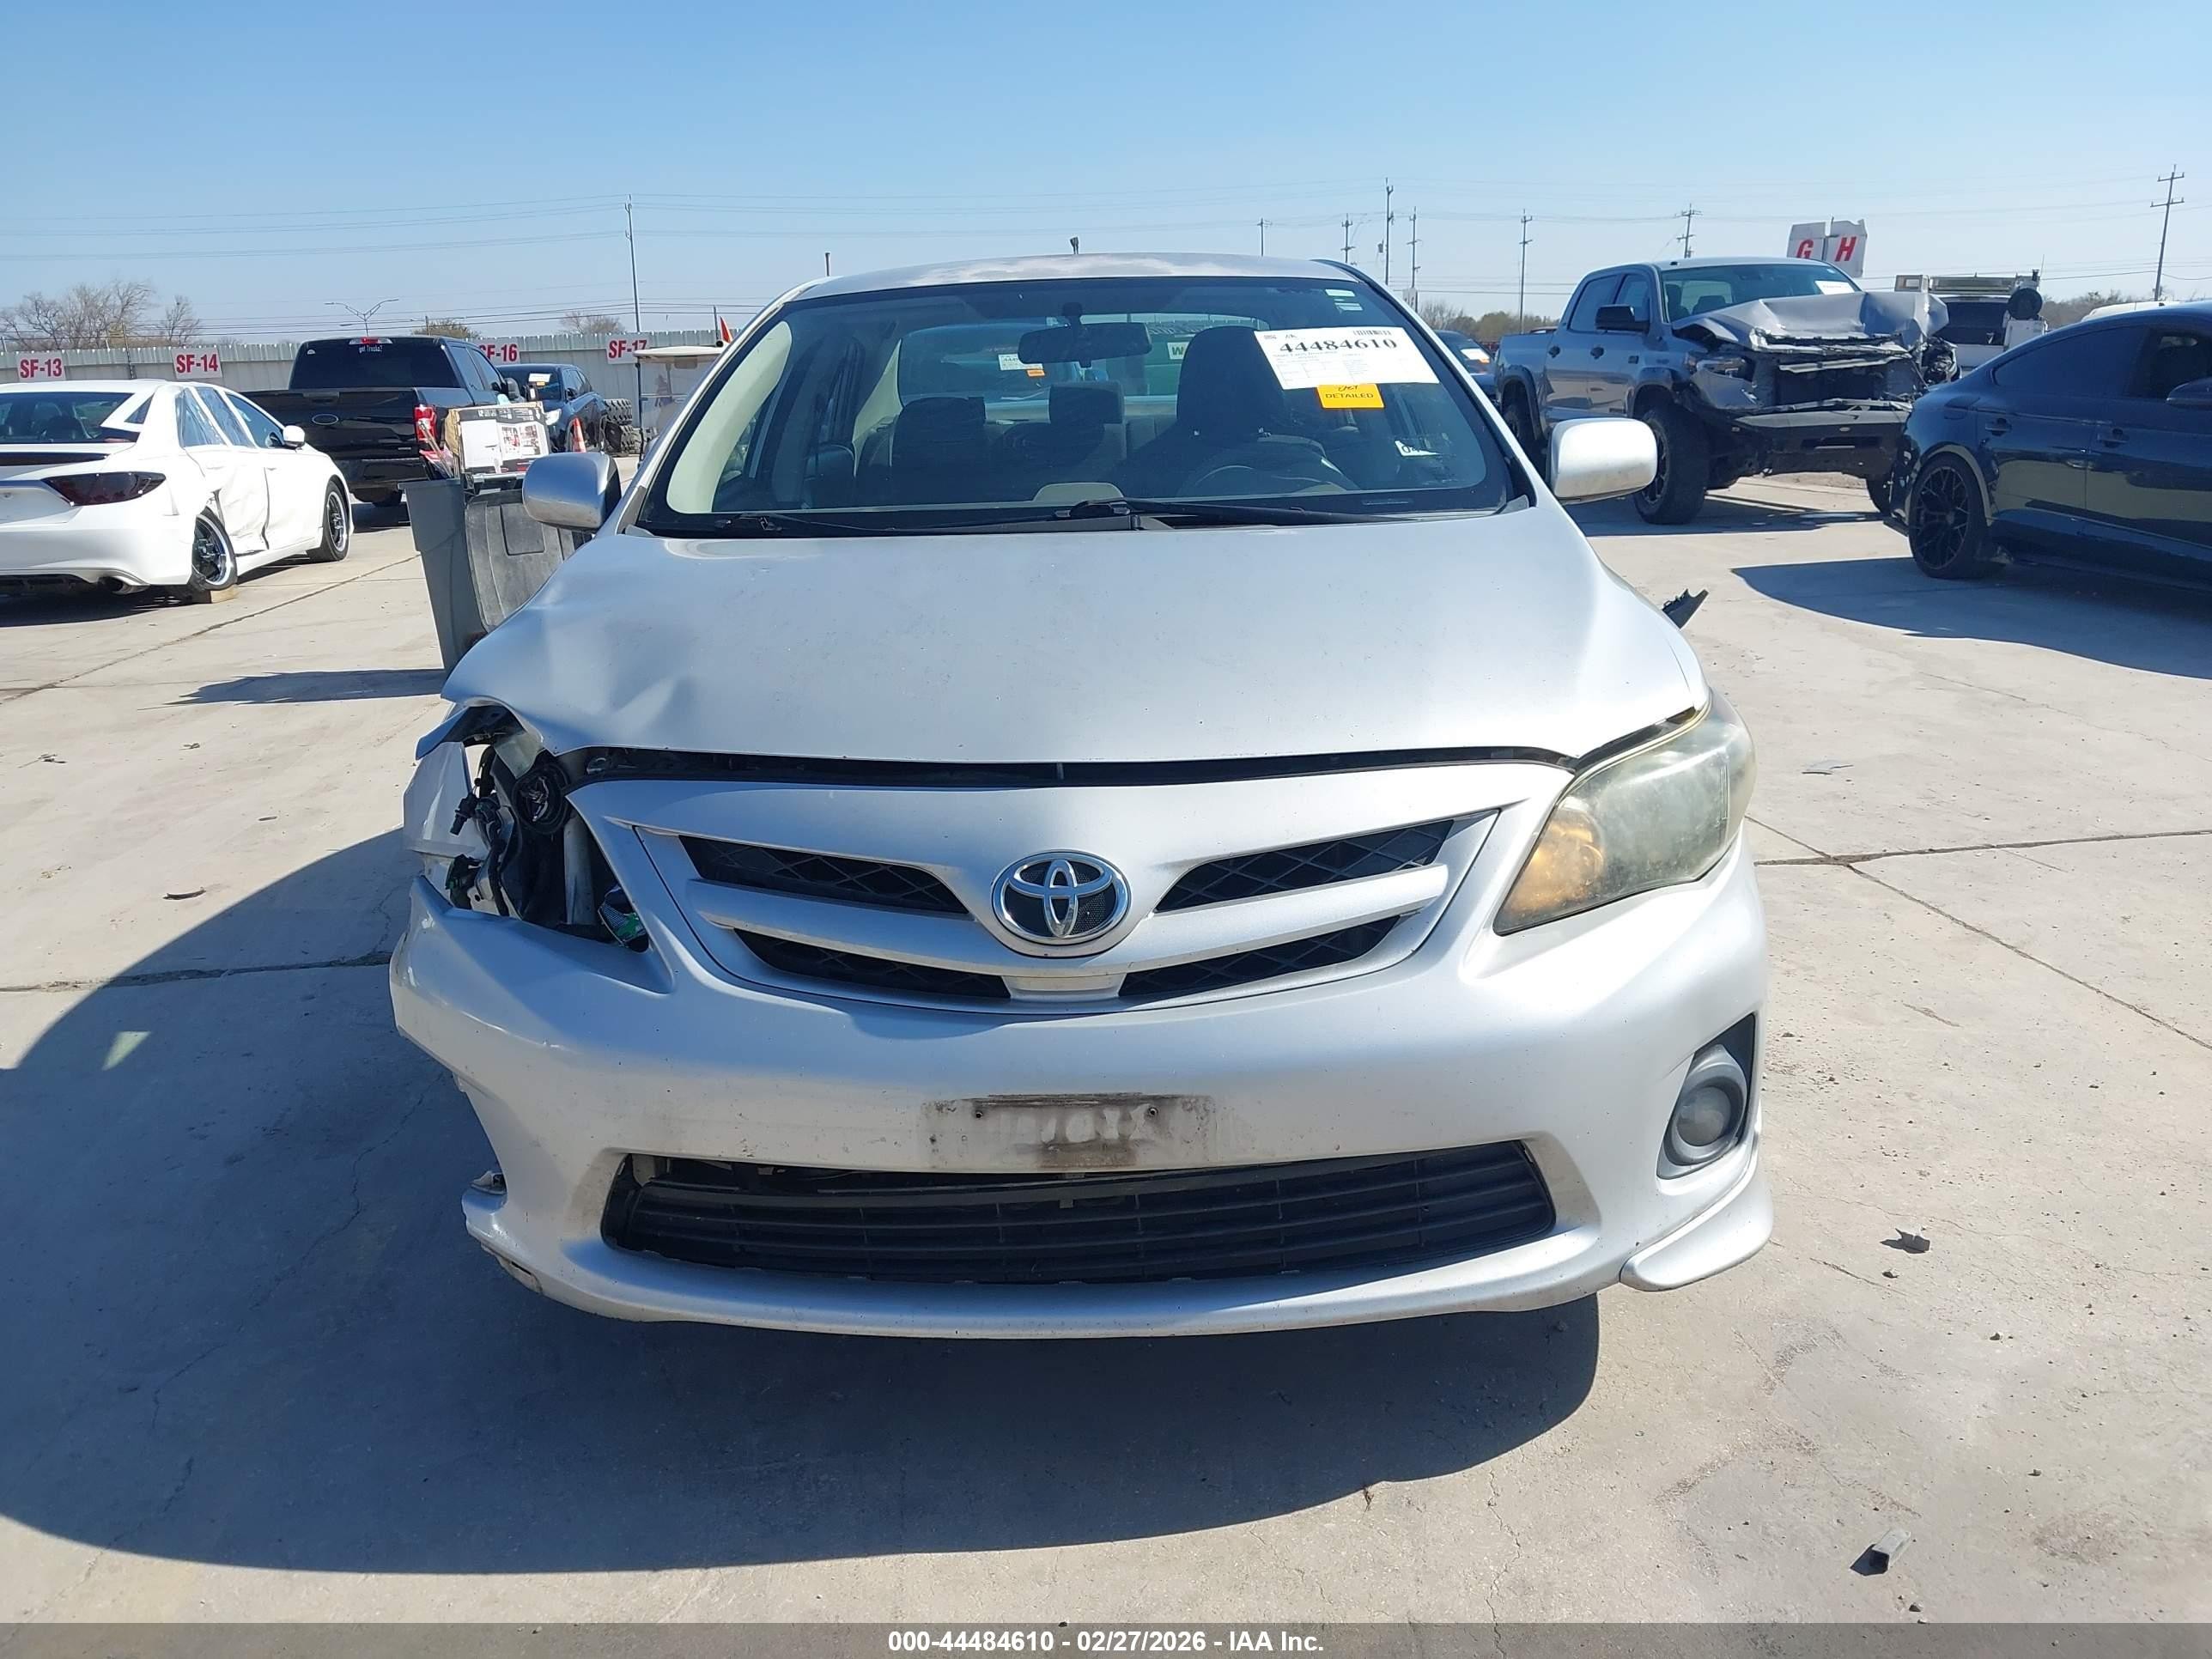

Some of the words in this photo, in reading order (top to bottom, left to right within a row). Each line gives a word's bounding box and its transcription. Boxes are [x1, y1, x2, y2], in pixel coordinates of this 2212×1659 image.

[1796, 239, 1814, 259] G
[1835, 236, 1856, 262] H
[609, 340, 647, 358] SF-17
[1279, 339, 1397, 353] 44484610
[20, 358, 63, 379] SF-13
[176, 354, 218, 374] SF-14
